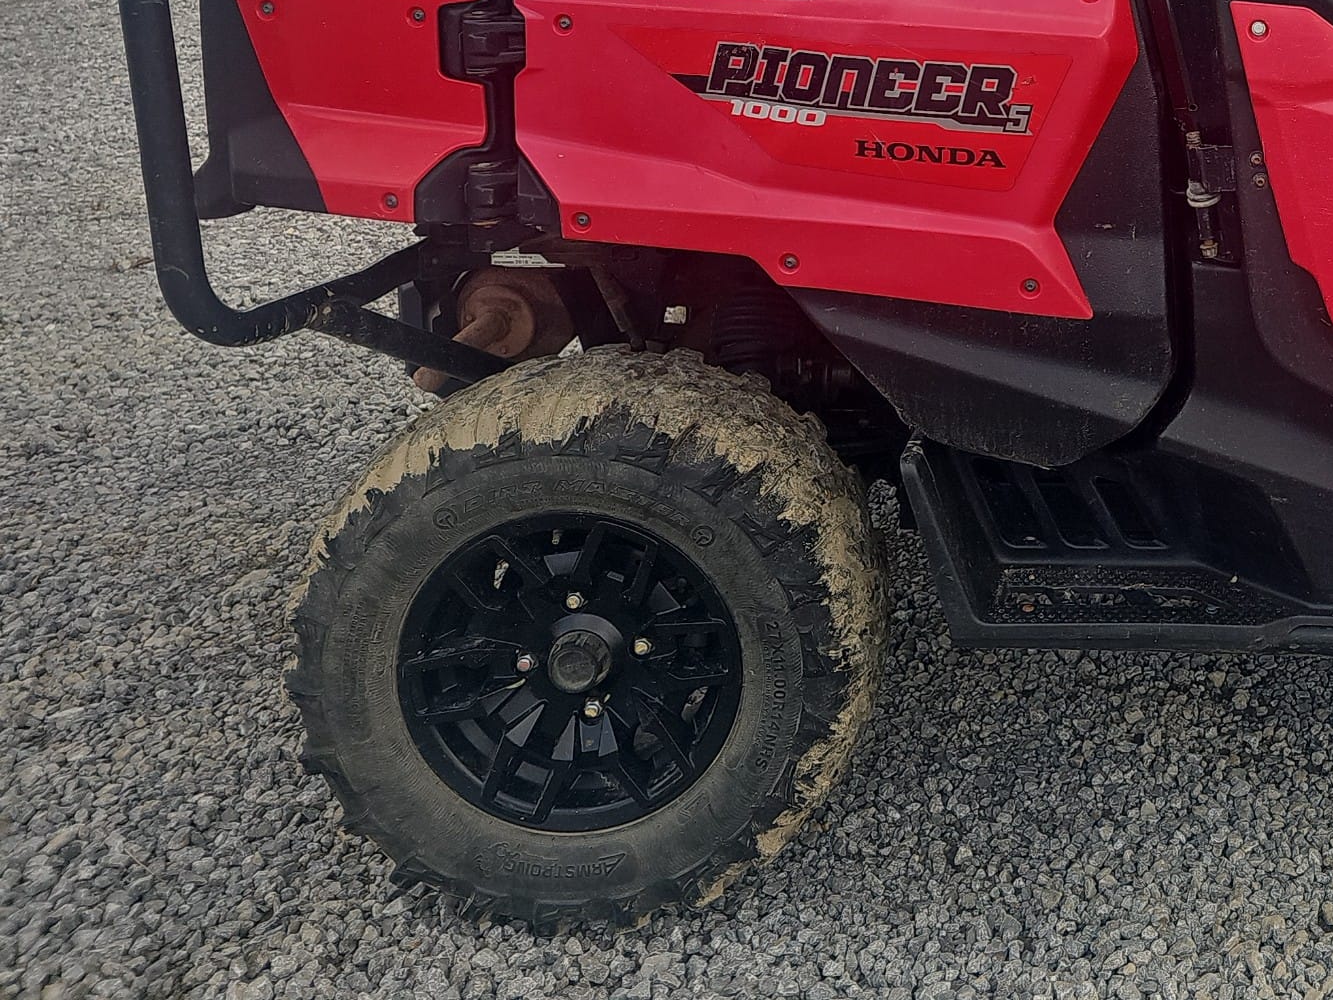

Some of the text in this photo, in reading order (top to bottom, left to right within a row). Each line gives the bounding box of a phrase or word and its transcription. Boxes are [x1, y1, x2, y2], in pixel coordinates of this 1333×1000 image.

[705, 40, 1018, 120] PIONEER
[729, 99, 827, 127] 1000
[854, 139, 1006, 168] HONDA
